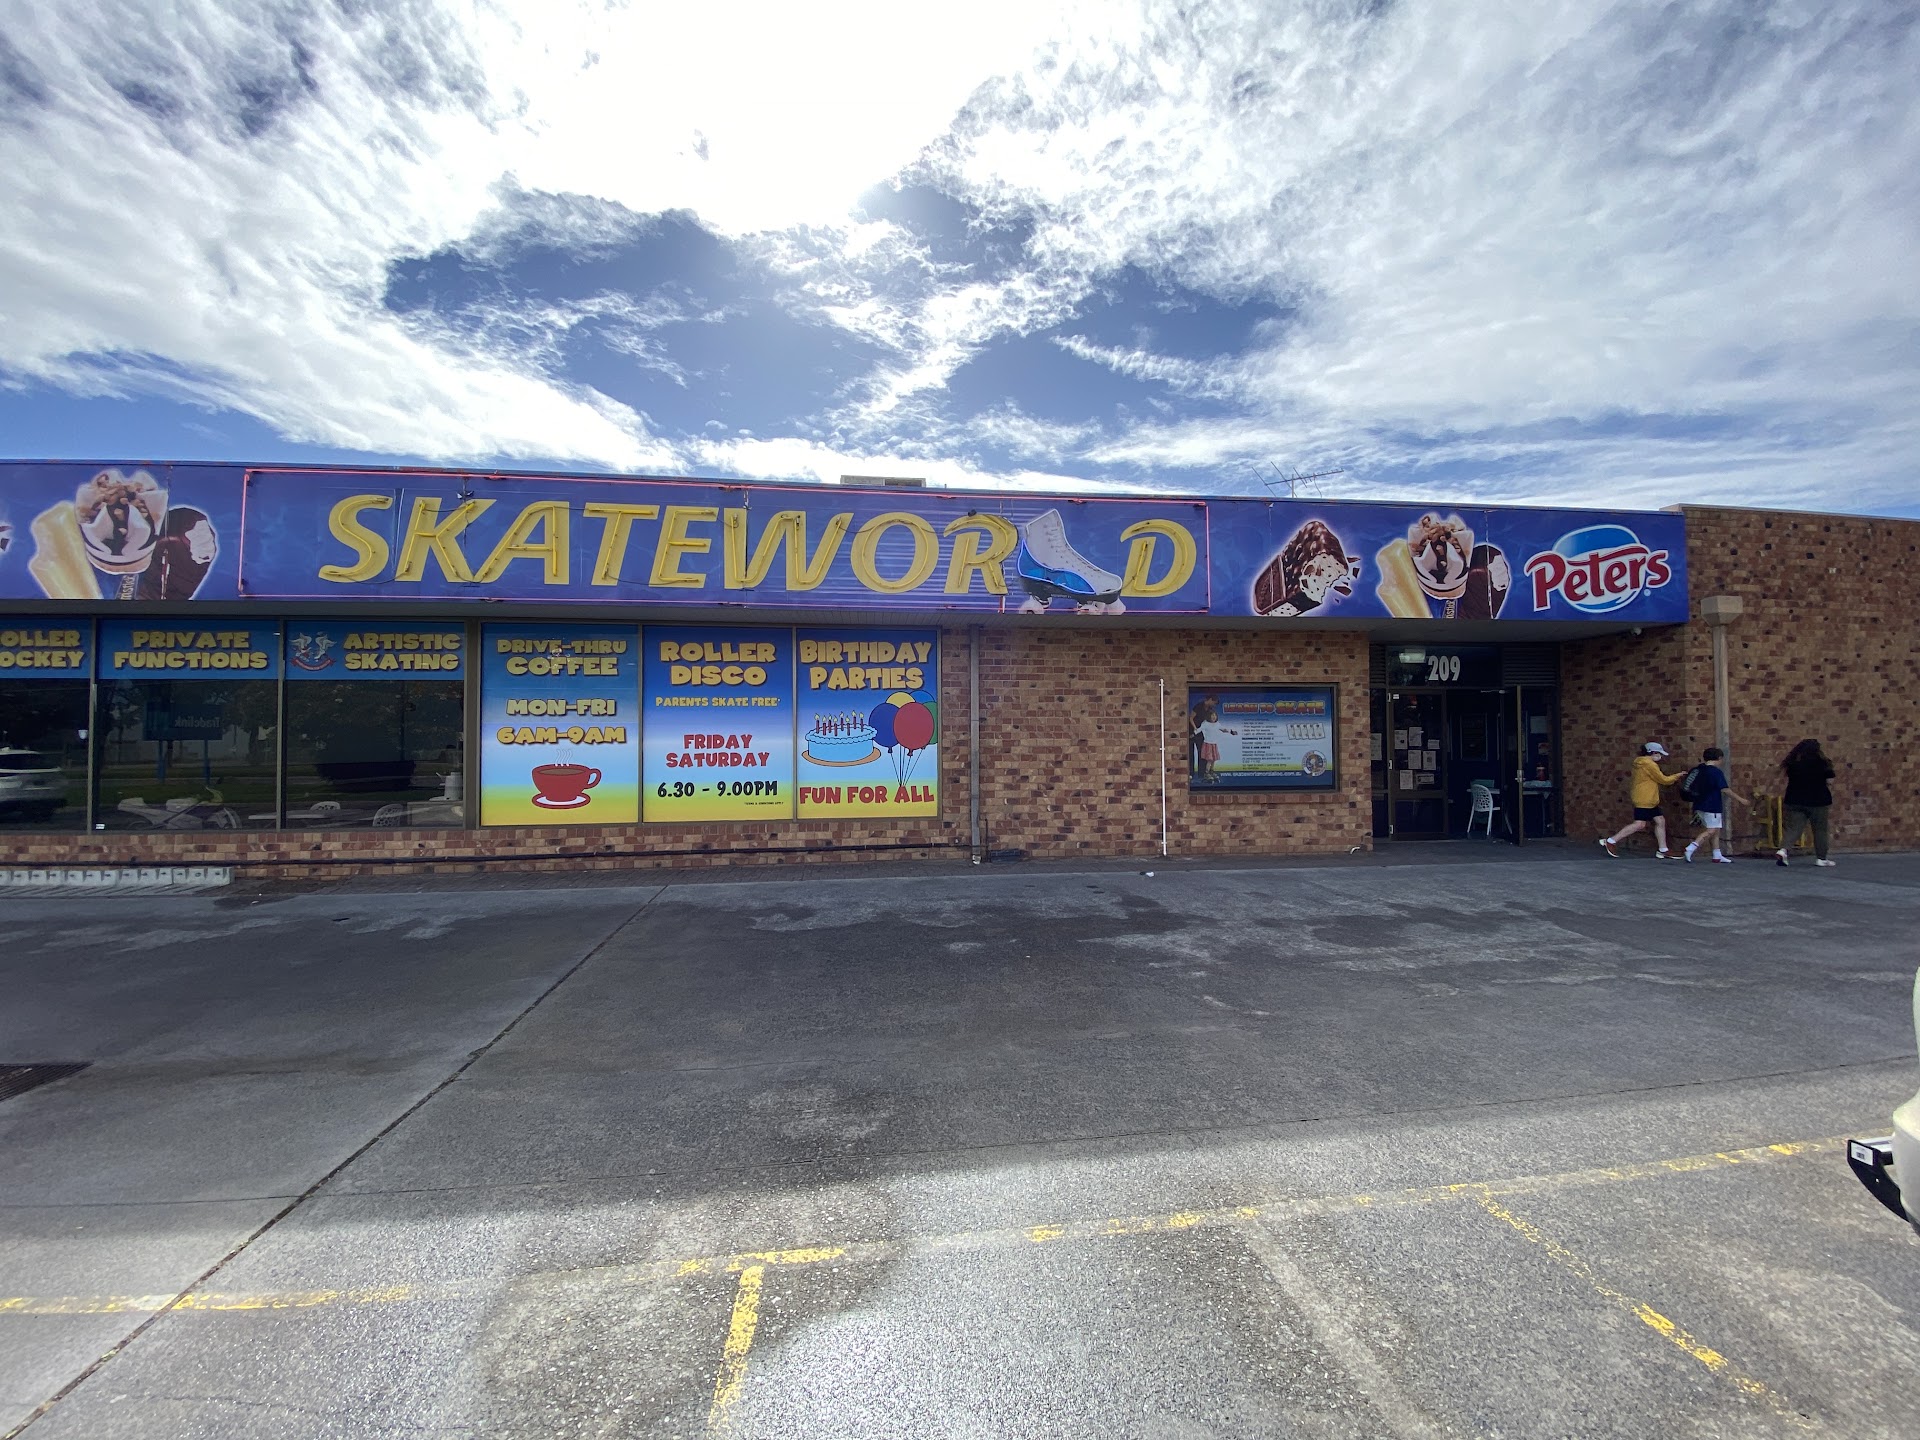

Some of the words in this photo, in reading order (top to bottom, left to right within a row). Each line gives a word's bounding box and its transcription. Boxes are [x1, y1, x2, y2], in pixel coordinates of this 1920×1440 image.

[1526, 545, 1671, 609] Peters
[132, 631, 249, 649] PRIVATE
[343, 633, 461, 650] ARTISTIC
[497, 639, 627, 654] DRIVE-THRU
[114, 651, 268, 669] FUNCTIONS
[660, 641, 777, 662] ROLLER
[799, 639, 932, 664] BIRTHDAY
[345, 652, 459, 670] SKATING
[506, 656, 618, 676] COFFEE
[1427, 655, 1461, 681] 209
[671, 665, 768, 686] DISCO
[809, 667, 924, 690] PARTIES
[506, 698, 617, 716] MON-FRI
[655, 697, 709, 707] PARENTS
[712, 697, 749, 707] SKATE
[1275, 701, 1325, 715] SKATE
[496, 726, 626, 744] 6AM-9AM
[683, 734, 753, 750] FRIDAY
[665, 752, 770, 768] SATURDAY
[657, 781, 696, 798] 6.30
[716, 780, 778, 797] 9.00PM
[799, 787, 841, 804] FUN
[847, 785, 888, 804] FOR
[893, 785, 935, 803] ALL
